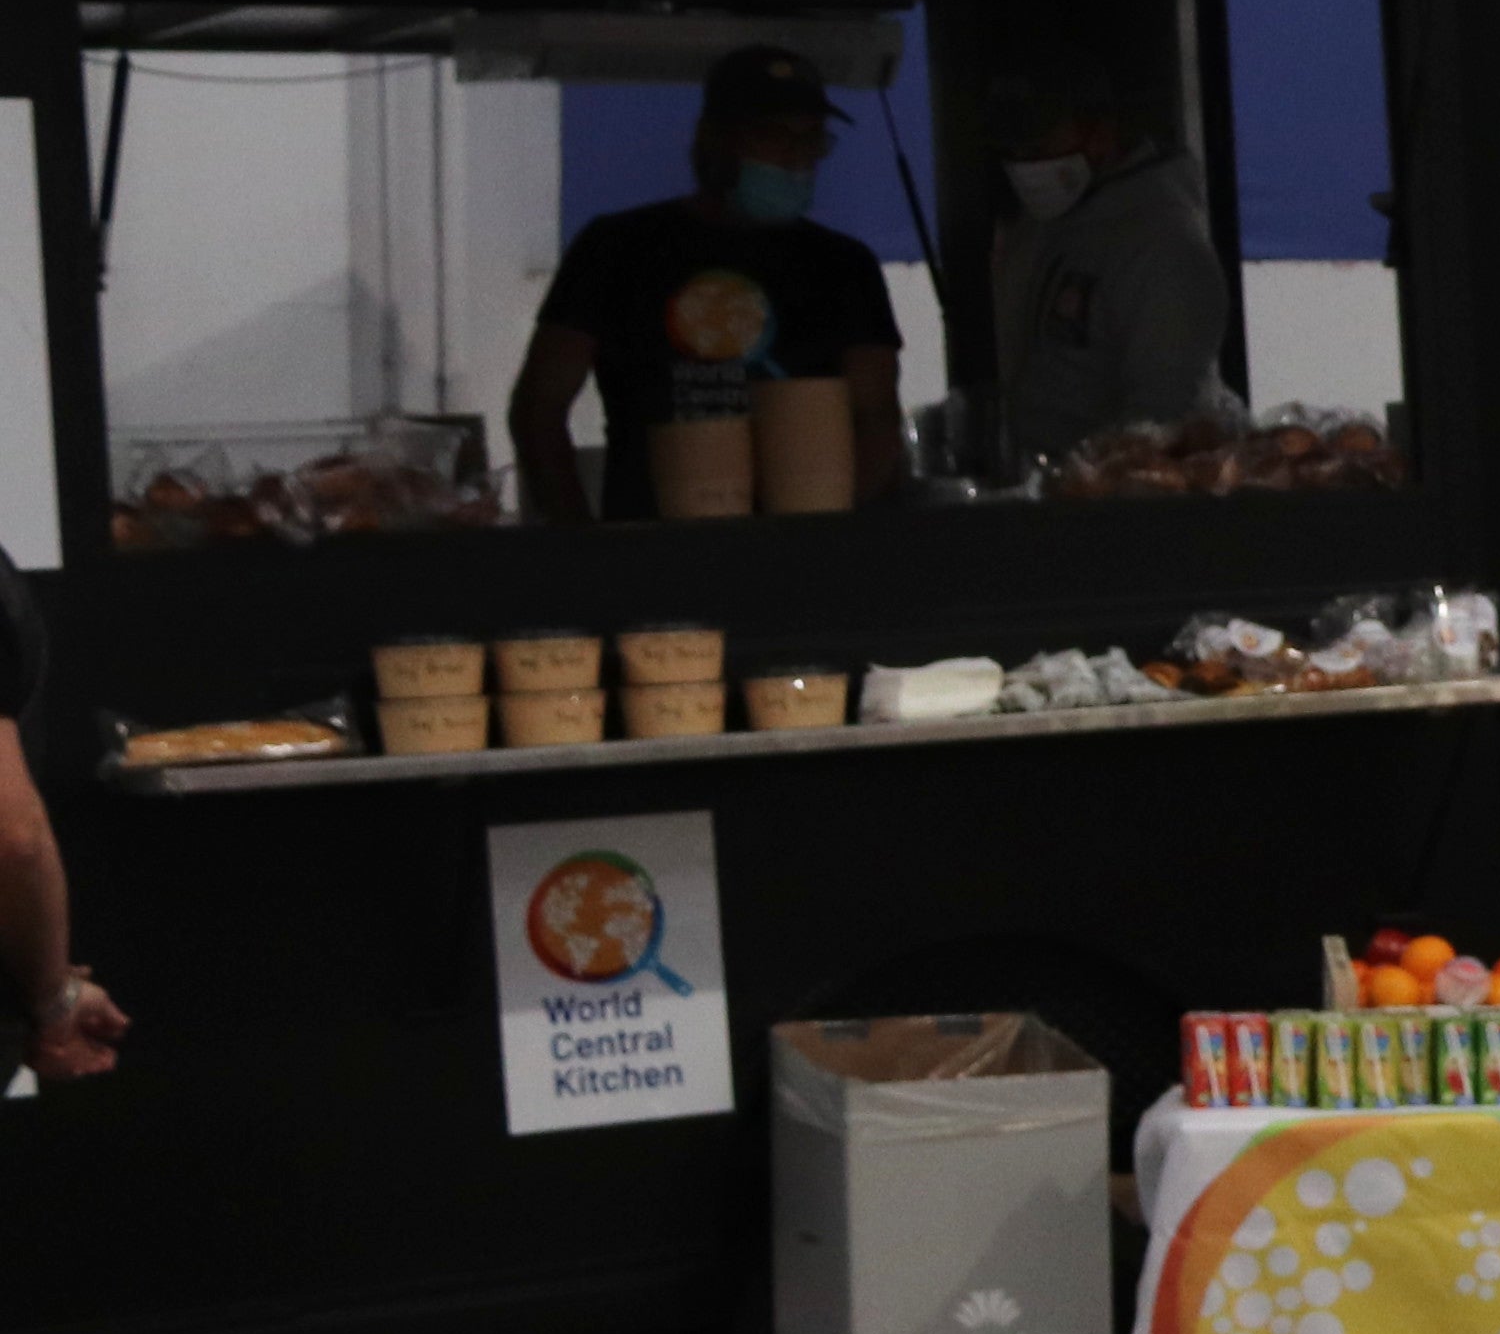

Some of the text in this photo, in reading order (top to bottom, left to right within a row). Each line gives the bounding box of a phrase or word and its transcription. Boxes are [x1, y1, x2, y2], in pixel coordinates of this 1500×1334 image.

[541, 988, 642, 1025] World
[551, 1021, 674, 1062] Central
[554, 1063, 685, 1098] Kitchen
